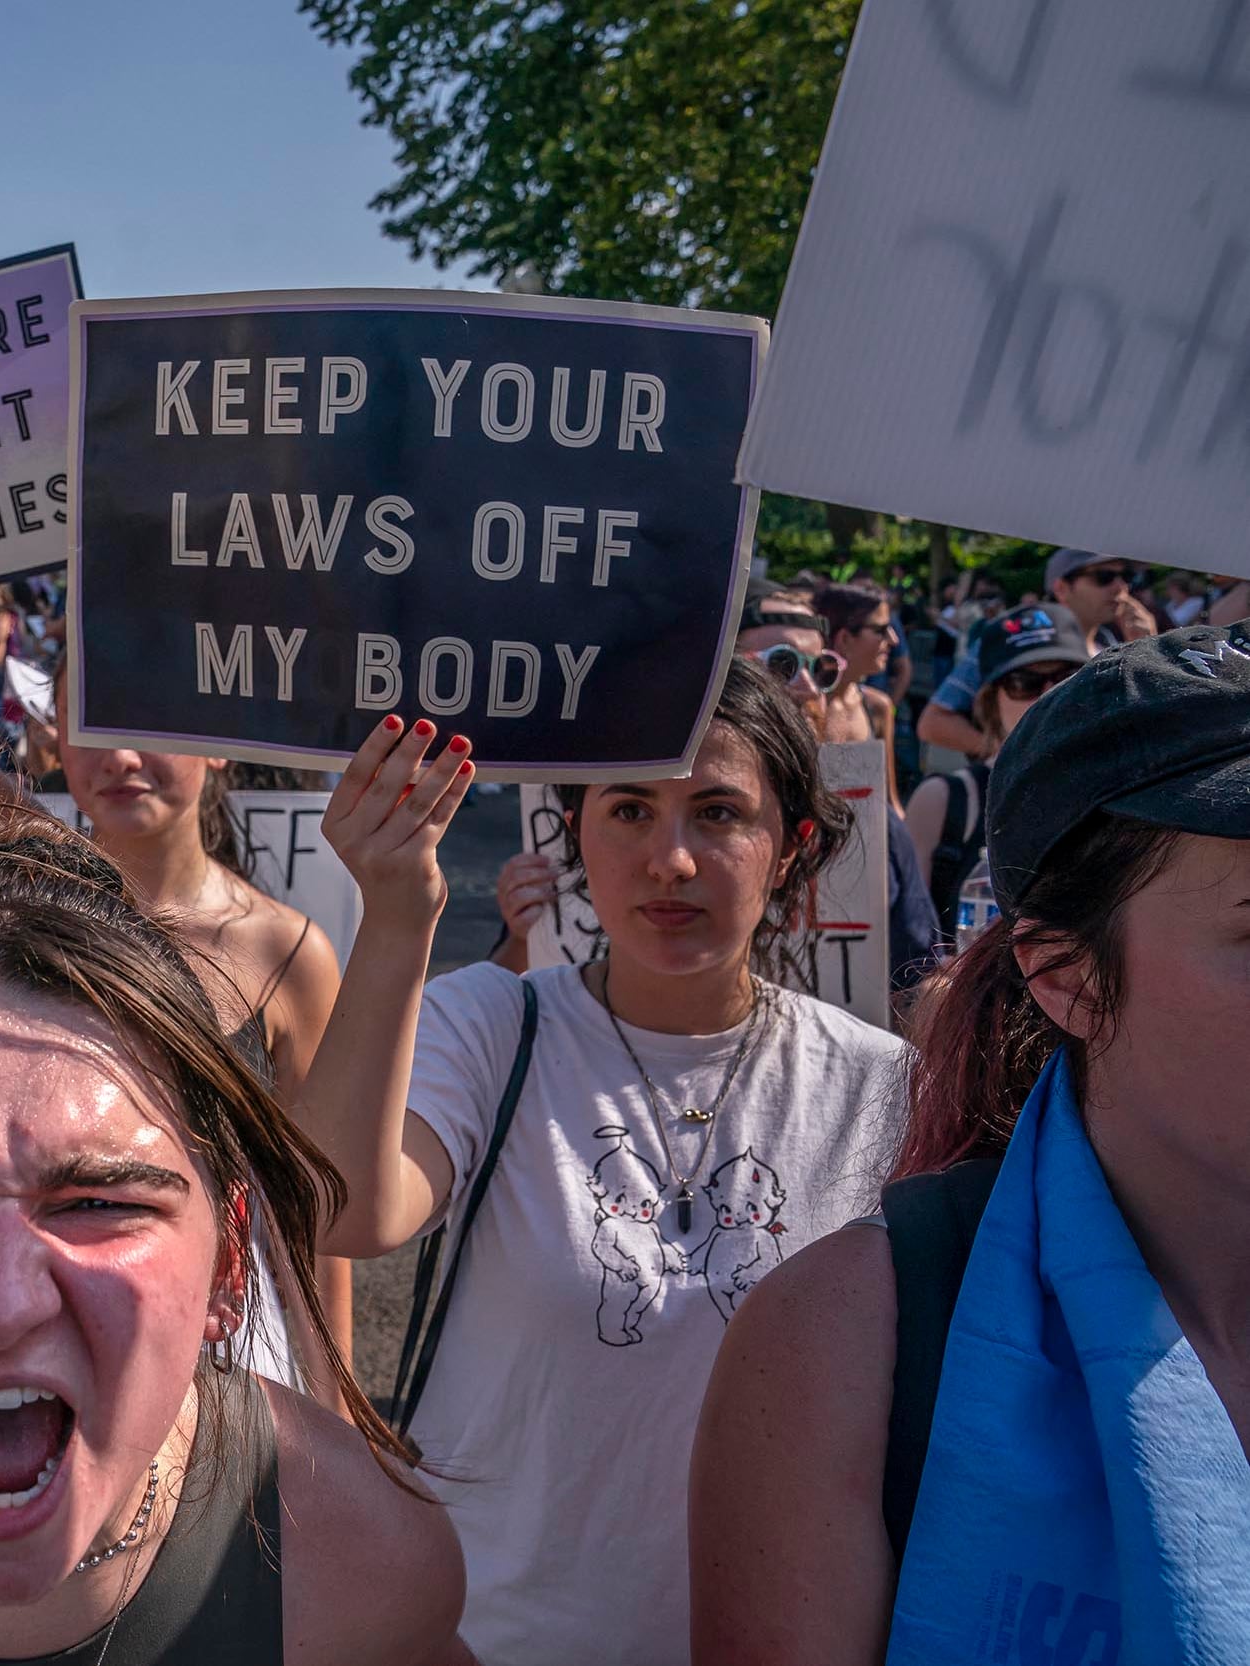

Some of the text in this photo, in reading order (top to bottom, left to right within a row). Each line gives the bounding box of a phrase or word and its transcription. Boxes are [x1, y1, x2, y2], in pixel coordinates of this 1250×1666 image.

[154, 355, 667, 454] KEEP YOUR
[170, 491, 639, 587] LAWS OFF
[194, 621, 602, 721] MY BODY
